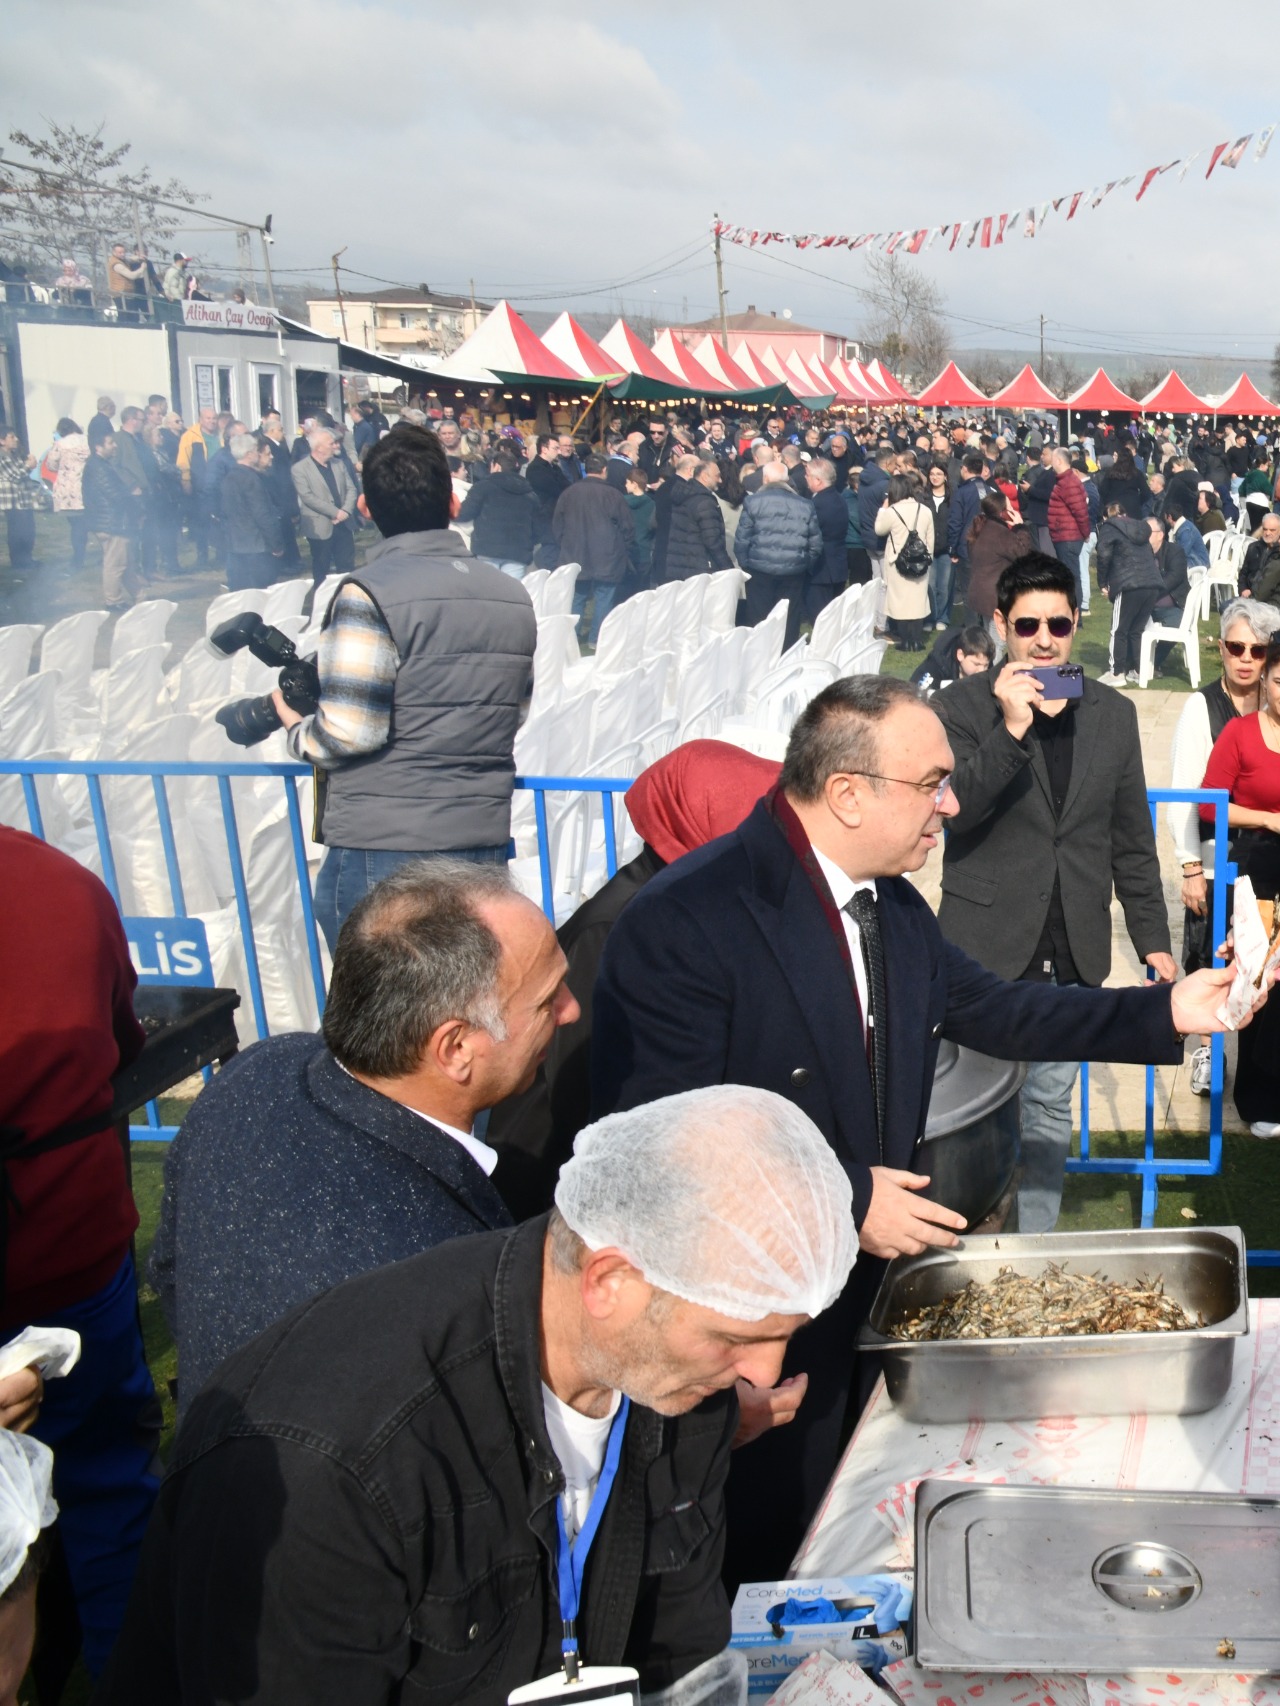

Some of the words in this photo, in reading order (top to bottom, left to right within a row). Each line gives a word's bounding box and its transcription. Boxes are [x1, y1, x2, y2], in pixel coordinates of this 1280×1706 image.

[185, 303, 222, 322] Alihan
[225, 307, 244, 327] Çay
[127, 931, 203, 976] LİS
[745, 1585, 824, 1599] CoreMed
[859, 1627, 871, 1638] L
[746, 1652, 810, 1670] oreMe
